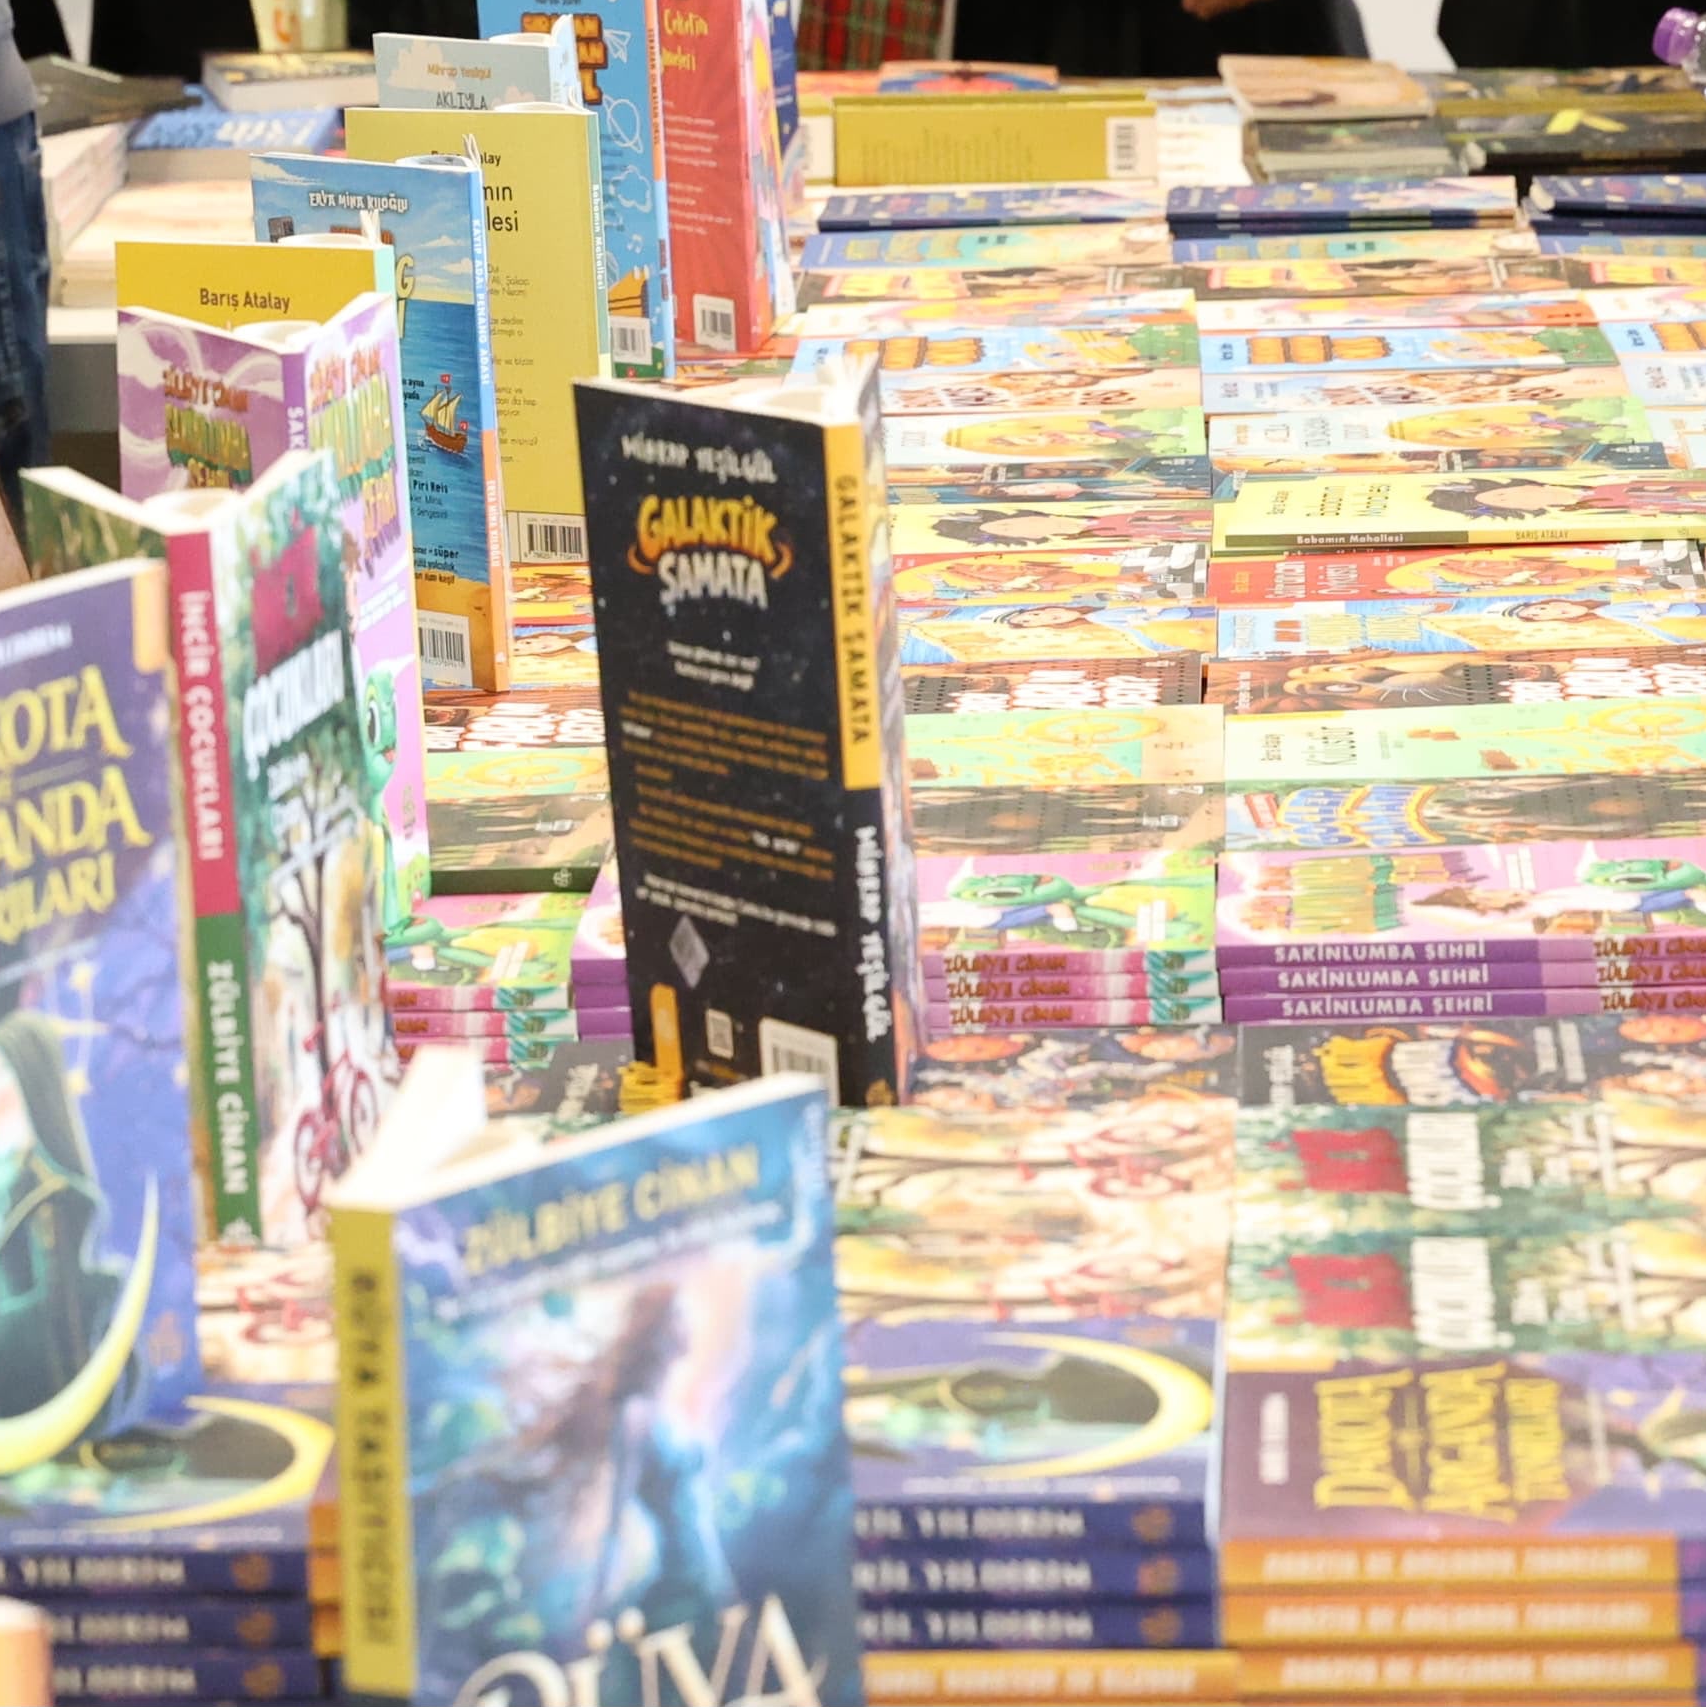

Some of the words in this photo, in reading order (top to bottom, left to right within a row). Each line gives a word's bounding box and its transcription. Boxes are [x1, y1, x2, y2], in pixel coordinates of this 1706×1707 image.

[199, 288, 239, 310] Barış
[243, 291, 290, 313] Atalay
[637, 495, 777, 565] GALAKTİK
[834, 474, 866, 617] GALAKTİK
[1274, 939, 1415, 962] SAKİNLUMBA
[1424, 939, 1485, 961] ŞEHRİ
[1278, 966, 1420, 988] SAKİNLUMBA
[1429, 963, 1489, 985] ŞEHRİ
[1282, 995, 1423, 1016] SAKİNLUMBA
[1432, 991, 1493, 1013] ŞEHRİ
